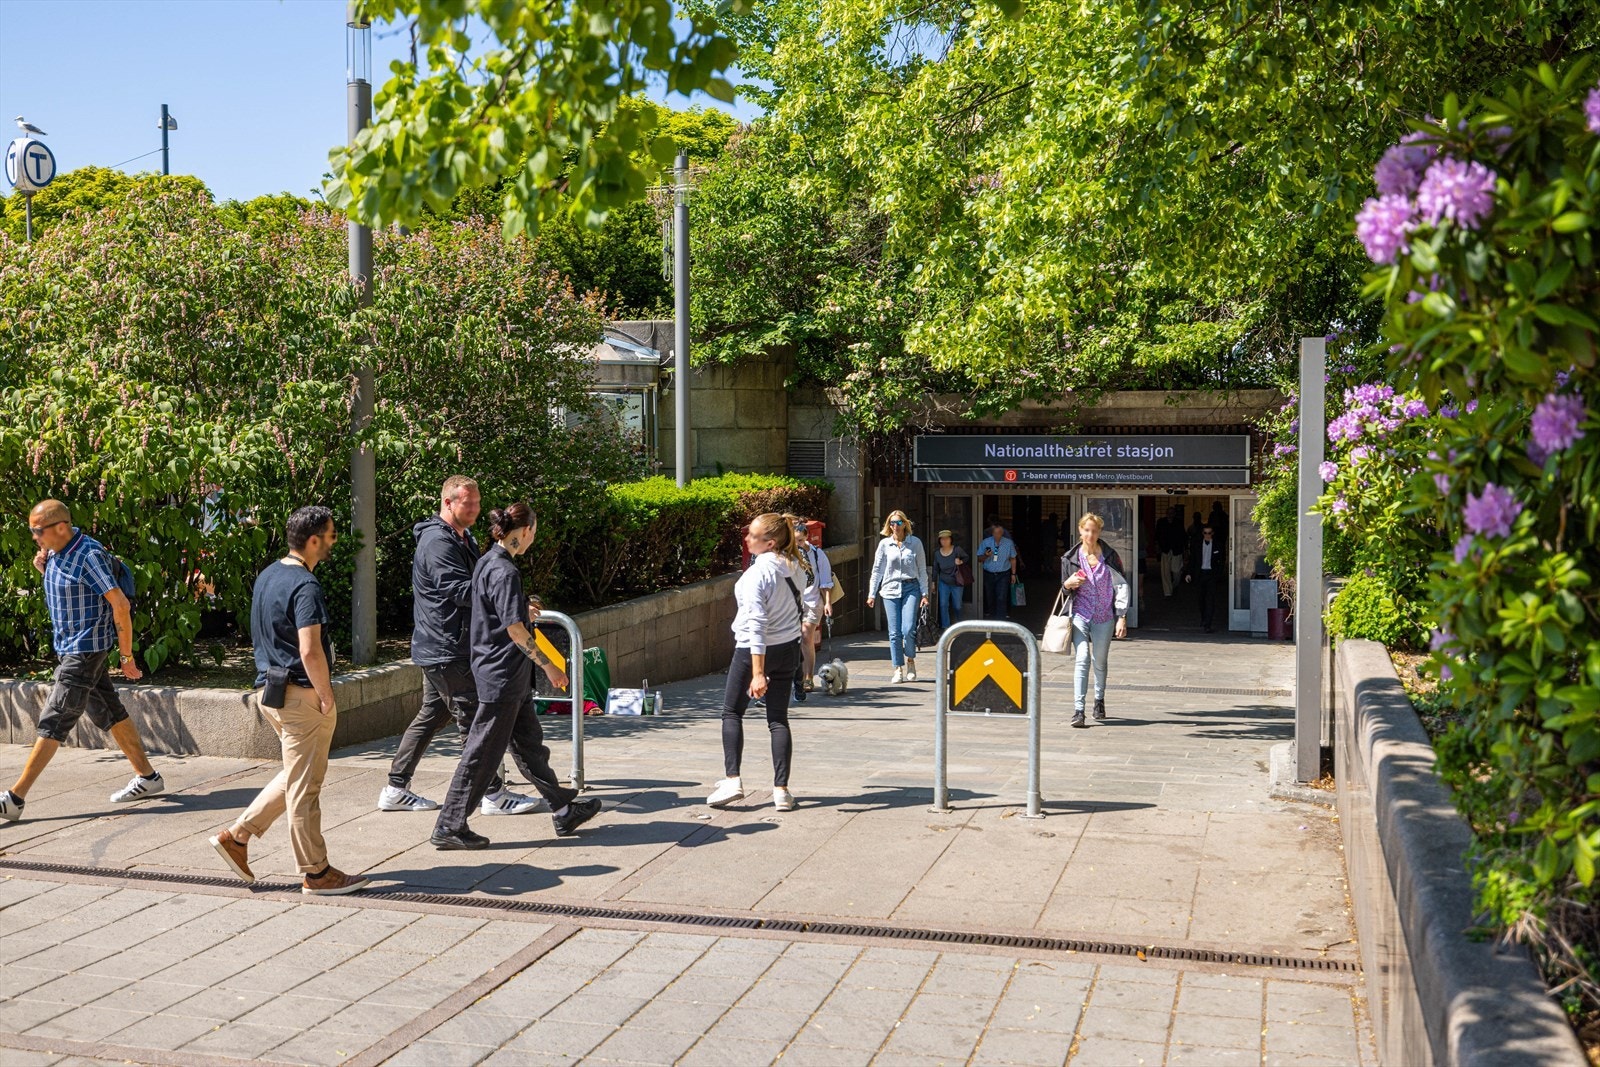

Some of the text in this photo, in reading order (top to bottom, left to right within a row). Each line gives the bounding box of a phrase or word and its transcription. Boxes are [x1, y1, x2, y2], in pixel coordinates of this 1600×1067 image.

[30, 152, 47, 180] T
[984, 443, 1174, 461] Nationaltheatret stasjon
[1022, 472, 1048, 480] T-bane
[1050, 472, 1077, 481] retning
